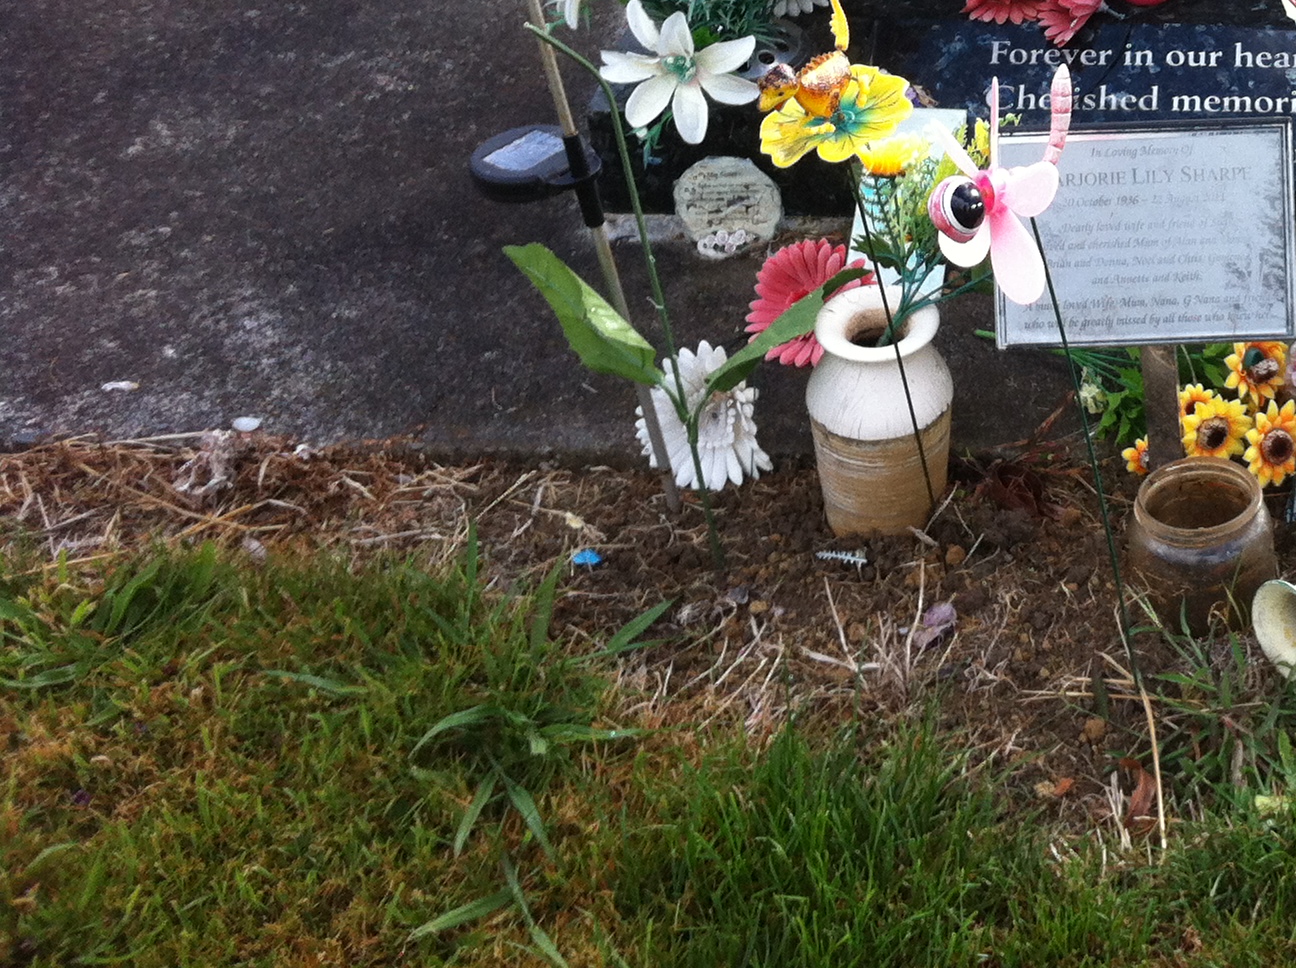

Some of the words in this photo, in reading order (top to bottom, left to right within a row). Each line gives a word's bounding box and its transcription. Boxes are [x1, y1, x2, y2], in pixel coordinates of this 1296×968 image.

[988, 39, 1113, 66] Forever
[1123, 43, 1156, 67] in
[1165, 48, 1223, 68] our
[982, 83, 1160, 112] Cheished
[1103, 146, 1138, 159] Loving
[1180, 165, 1253, 183] SHARPE
